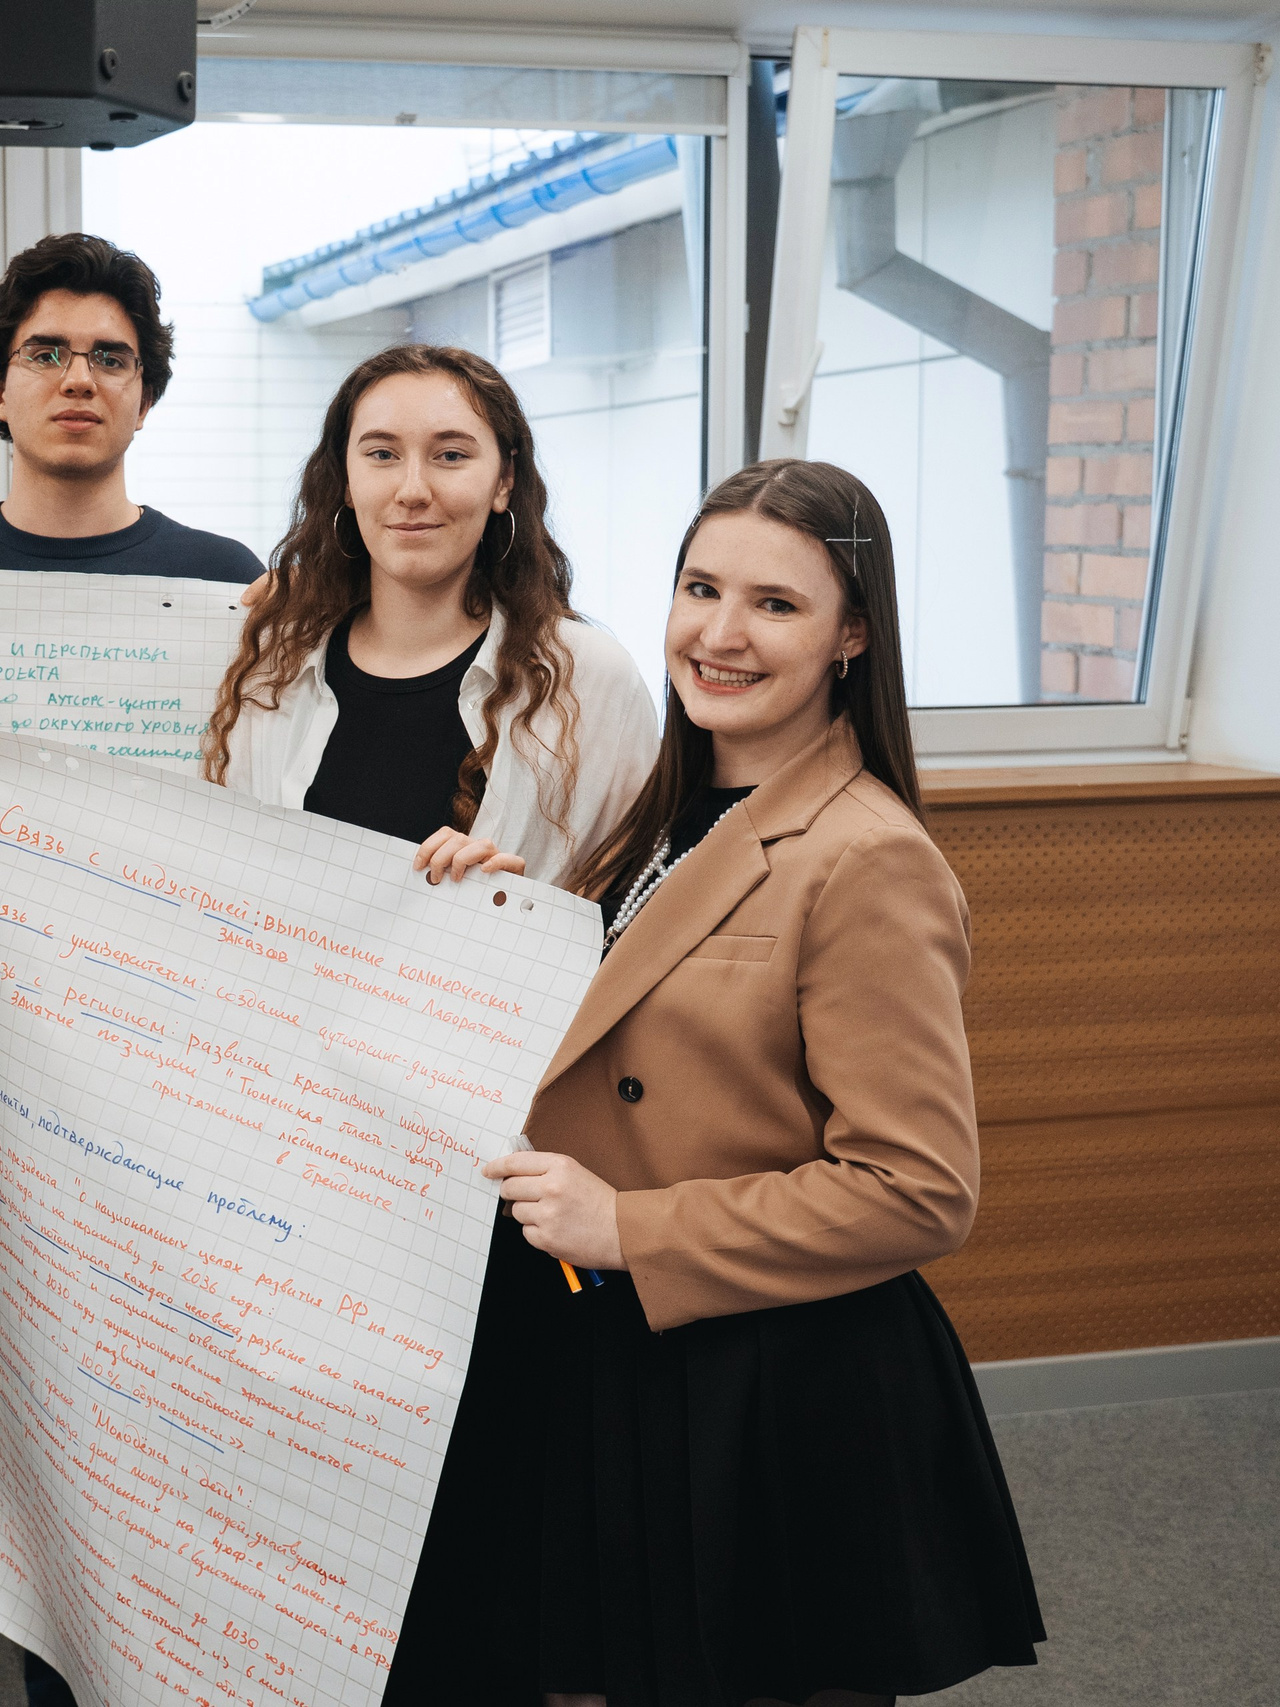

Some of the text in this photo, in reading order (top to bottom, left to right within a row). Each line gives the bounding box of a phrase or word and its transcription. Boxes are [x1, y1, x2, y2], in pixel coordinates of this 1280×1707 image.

[0, 805, 64, 854] Связь
[396, 964, 522, 1018] коммерческих
[338, 1294, 368, 1324] РФ
